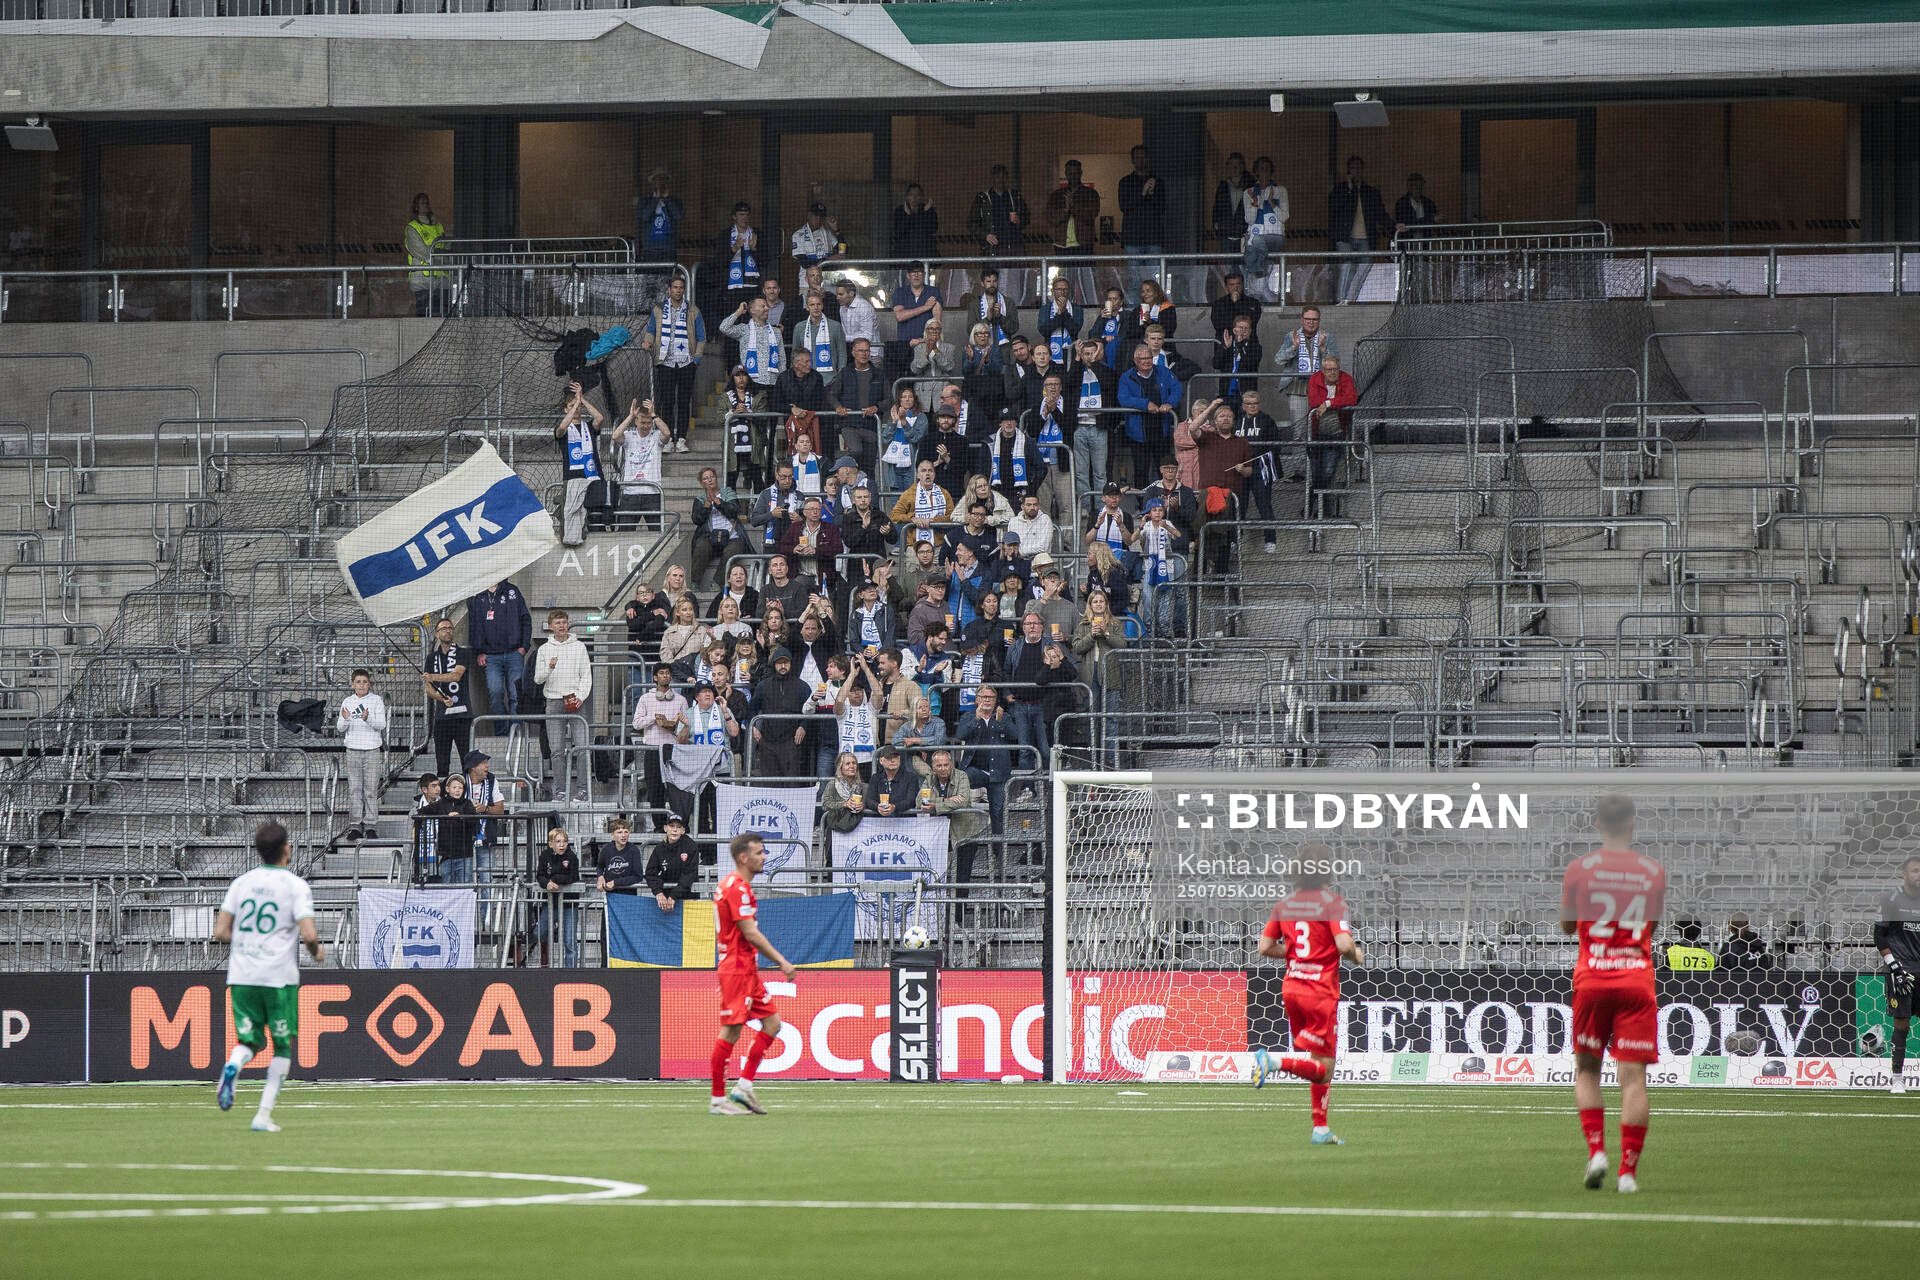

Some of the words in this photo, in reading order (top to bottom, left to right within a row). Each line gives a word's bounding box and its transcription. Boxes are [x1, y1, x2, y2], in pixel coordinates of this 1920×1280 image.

[405, 501, 503, 571] IFK
[556, 544, 646, 576] A118
[751, 815, 779, 827] IFK
[871, 852, 906, 865] IFK
[238, 898, 279, 934] 26
[1588, 891, 1648, 940] 24
[1295, 921, 1311, 958] 3
[1683, 956, 1708, 969] 075
[458, 983, 617, 1068] AB
[898, 968, 929, 1080] SELECT
[1200, 1055, 1239, 1073] ICA
[1398, 1067, 1421, 1075] Eats
[1494, 1057, 1535, 1075] ICA
[1795, 1061, 1837, 1079] ICA
[1697, 1070, 1720, 1079] Eats
